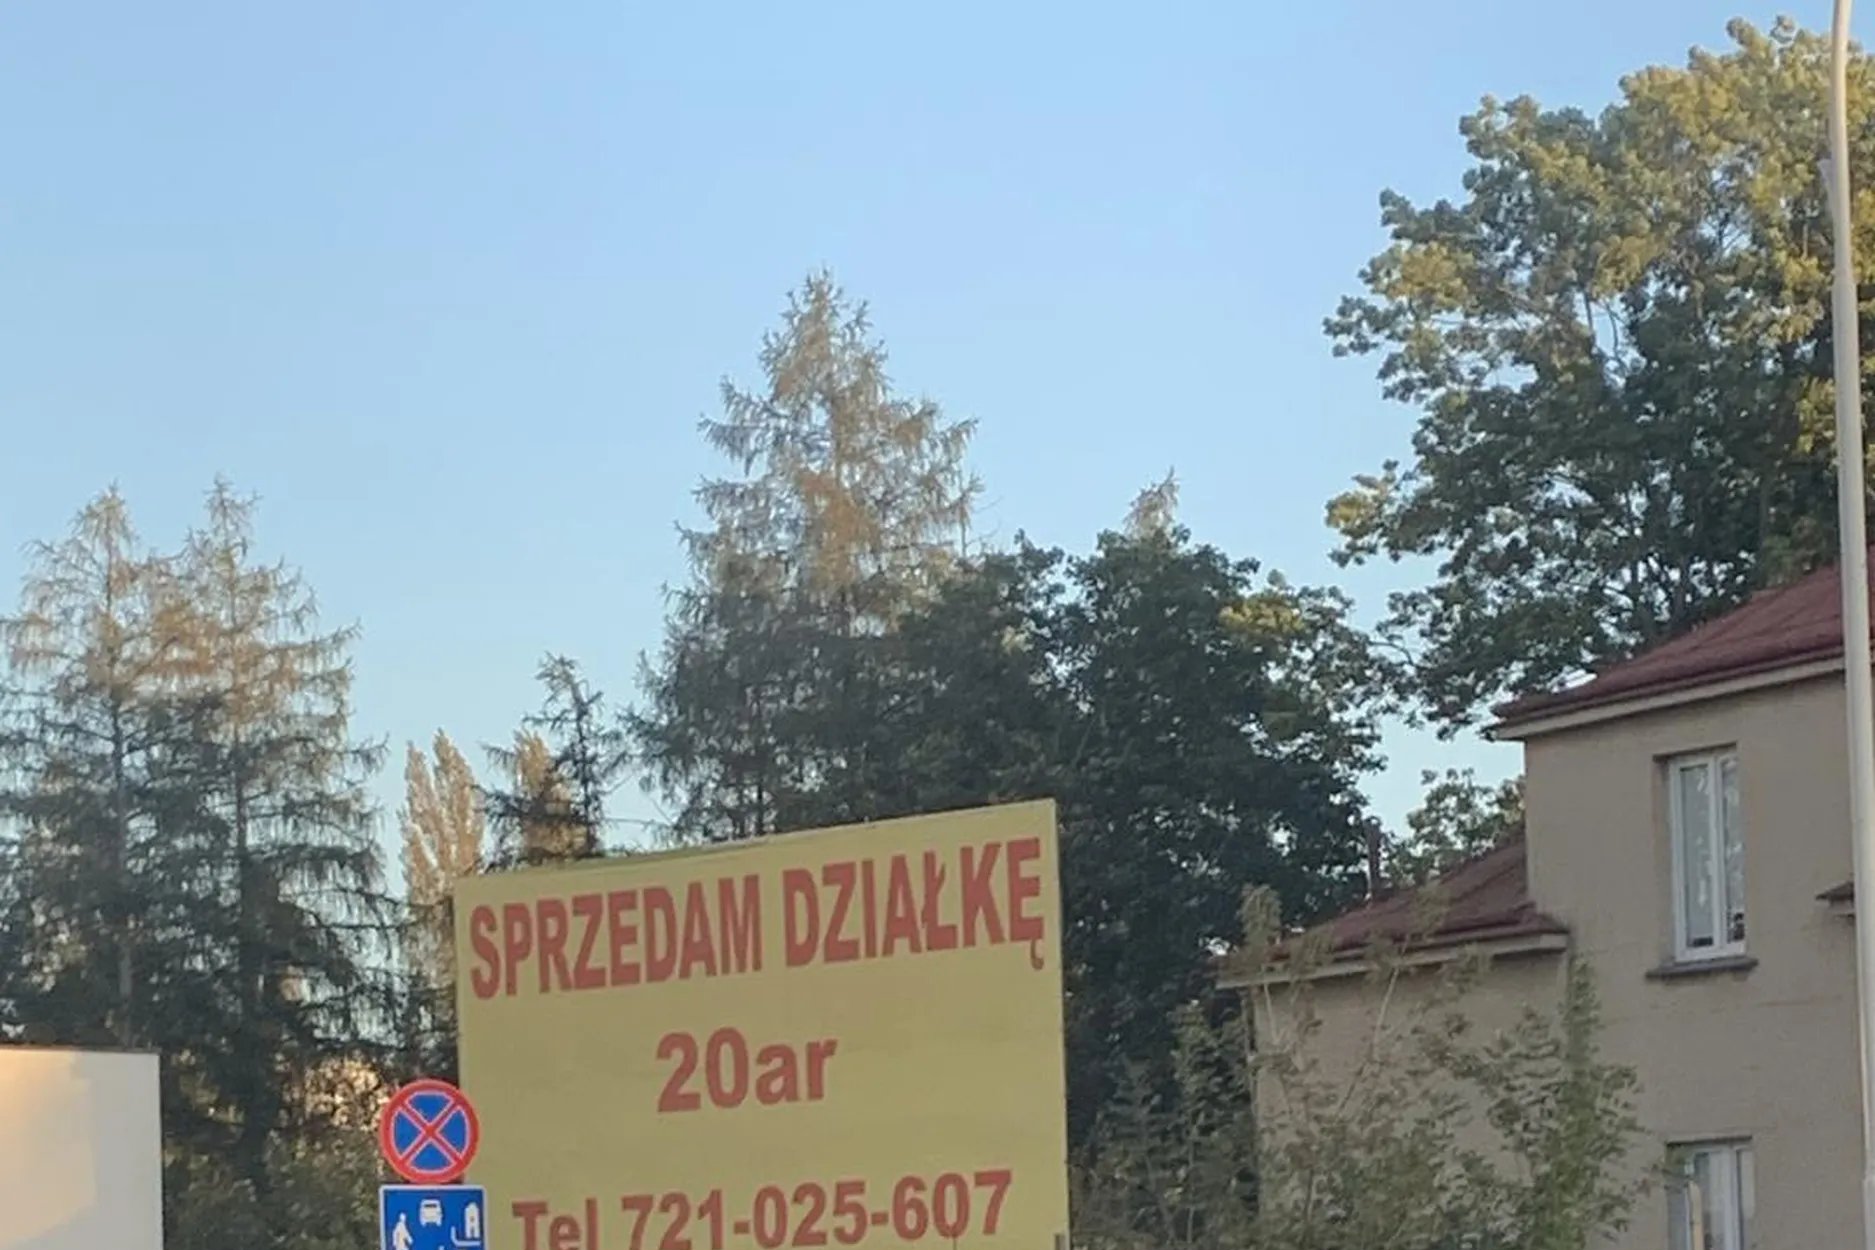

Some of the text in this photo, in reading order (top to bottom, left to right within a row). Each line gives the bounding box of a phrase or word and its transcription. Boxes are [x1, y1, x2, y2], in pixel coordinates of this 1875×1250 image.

[470, 836, 1046, 1000] SPRZEDAM DZIAŁKĘ
[656, 1027, 839, 1113] 20ar
